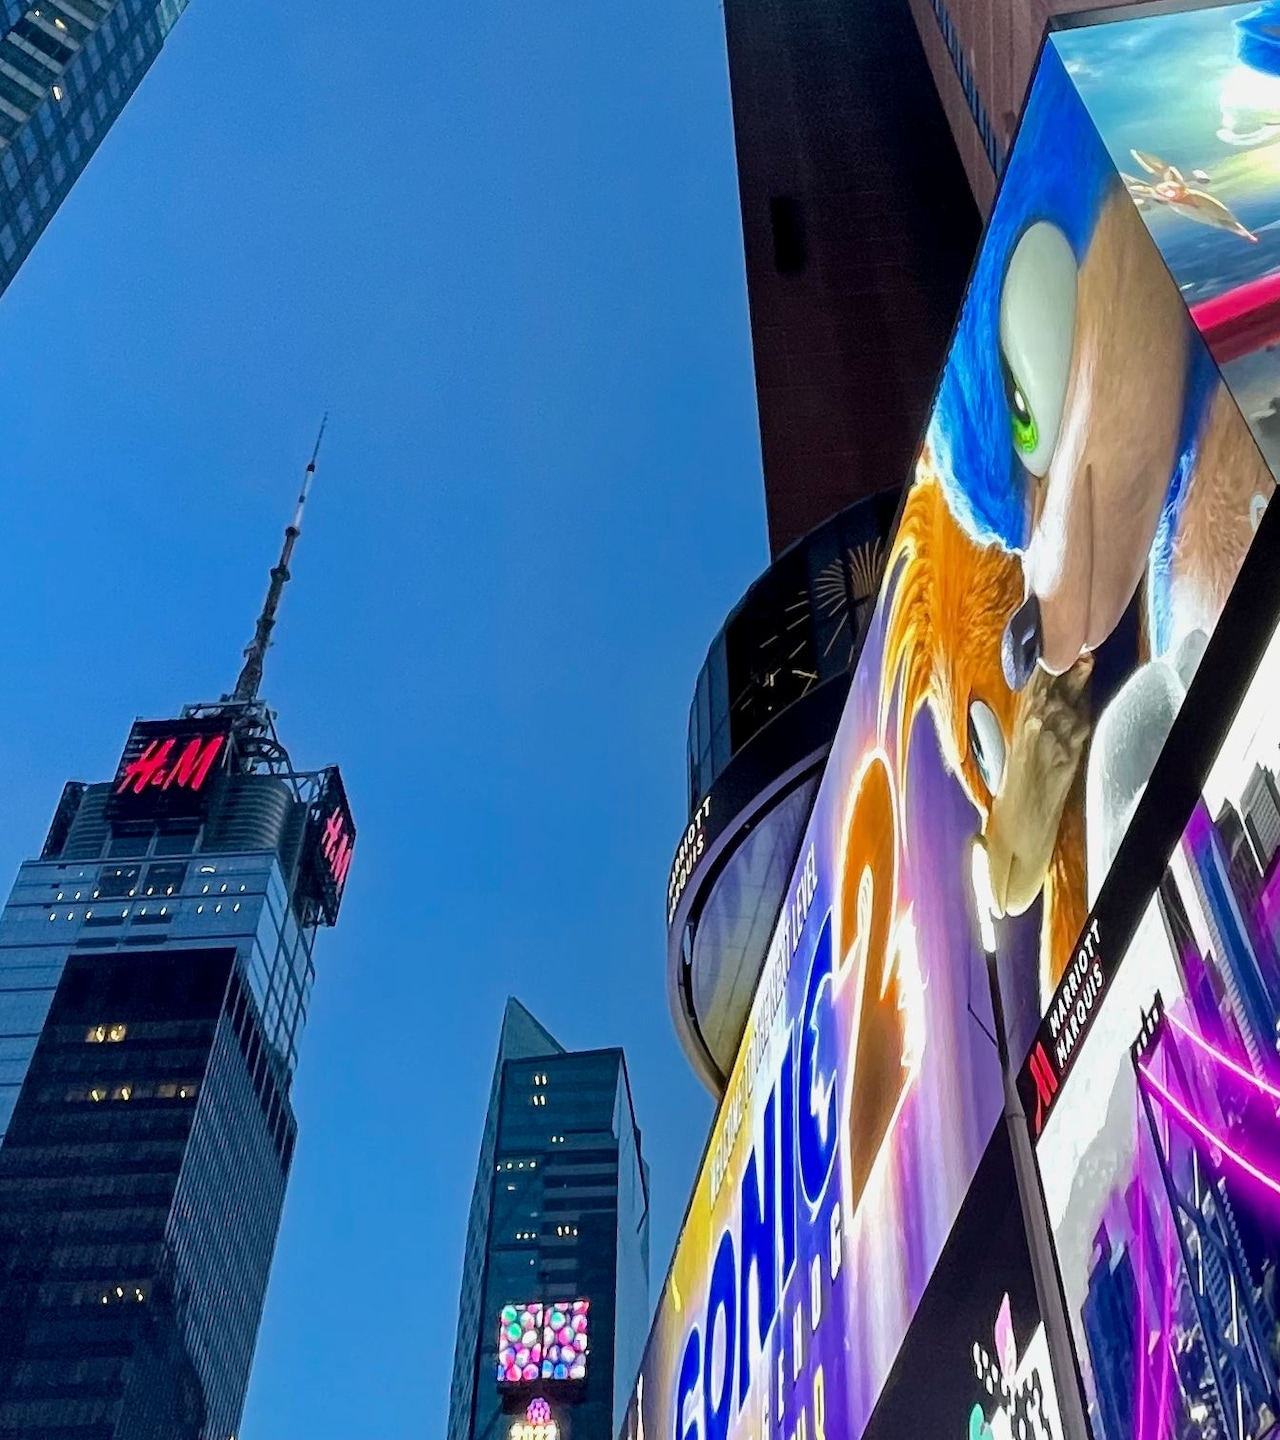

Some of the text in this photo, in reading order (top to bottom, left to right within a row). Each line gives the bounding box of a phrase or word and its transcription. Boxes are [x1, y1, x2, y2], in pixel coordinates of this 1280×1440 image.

[117, 735, 225, 795] H&M
[321, 807, 352, 887] H&M
[792, 842, 818, 952] LEVEL
[1050, 919, 1102, 1037] MARRIOTT
[1056, 963, 1103, 1068] MARQUIS
